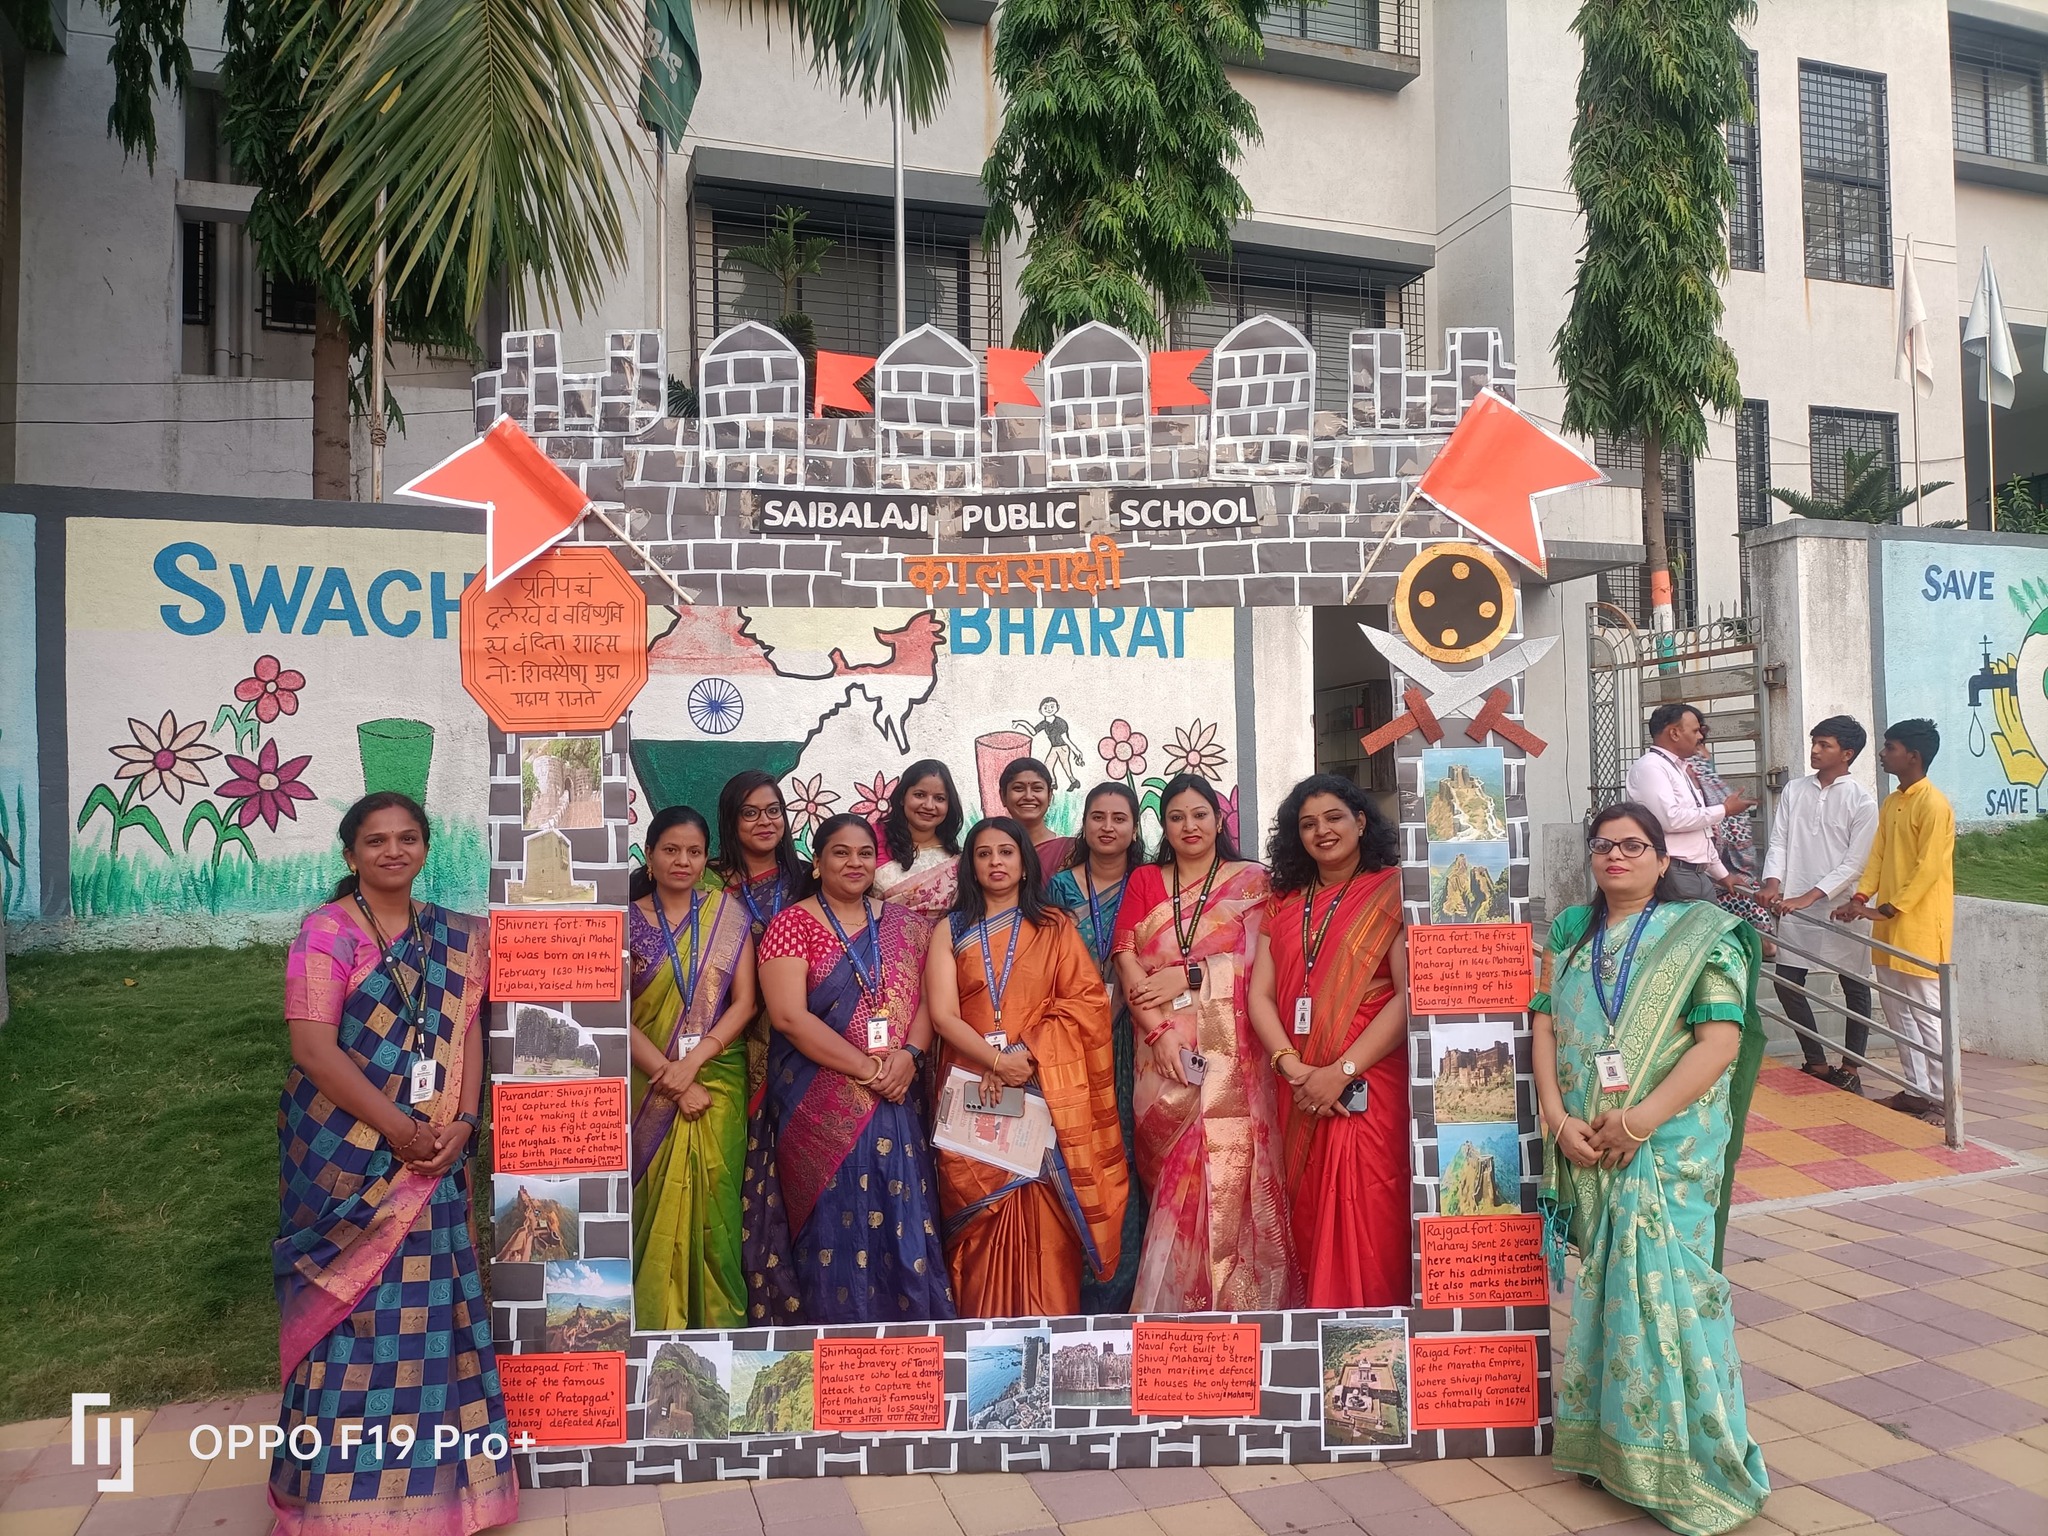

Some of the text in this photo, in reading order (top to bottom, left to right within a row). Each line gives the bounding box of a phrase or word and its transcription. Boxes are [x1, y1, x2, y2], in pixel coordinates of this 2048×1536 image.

[764, 498, 1256, 532] SAIBALAJI PUBLIC SCHOOL
[904, 535, 1124, 597] कालसाक्षी
[1922, 565, 1994, 601] SAVE
[949, 607, 1198, 658] BHARAT
[1985, 788, 2028, 816] SAVE
[498, 919, 606, 930] Shivneri This
[498, 935, 546, 944] is where
[1414, 933, 1445, 942] Torna
[1493, 930, 1516, 940] first
[1415, 943, 1525, 955] fort by Shivaji
[498, 952, 511, 962] raj
[544, 951, 568, 959] born
[1415, 961, 1454, 970] Maharaj
[499, 966, 593, 979] February 1630 His
[1440, 969, 1460, 980] just
[1502, 969, 1517, 977] This
[539, 980, 593, 990] raised him
[1416, 981, 1513, 994] the beginning of his
[556, 1088, 591, 1098] Shivaji
[571, 1099, 589, 1107] this
[594, 1097, 614, 1107] fort
[501, 1114, 510, 1122] in
[541, 1111, 575, 1122] making
[581, 1111, 588, 1119] it
[525, 1120, 621, 1135] of his fight against
[502, 1139, 516, 1148] the
[562, 1135, 581, 1143] This
[585, 1133, 606, 1143] fort
[500, 1144, 585, 1159] also birth of
[1427, 1221, 1535, 1240] Rajgad Shivaji
[1427, 1242, 1468, 1252] Maharaj
[1500, 1239, 1511, 1247] 26
[1427, 1254, 1496, 1265] here making
[1428, 1264, 1542, 1279] for his administration
[1429, 1281, 1439, 1290] It
[1443, 1280, 1463, 1289] also
[1470, 1278, 1499, 1288] marks
[1429, 1290, 1532, 1302] of his Rajaram
[1138, 1331, 1239, 1344] Shindhudurg A
[821, 1346, 938, 1359] Shinhagad Known
[1138, 1342, 1235, 1354] Naval fort built by
[1416, 1345, 1494, 1361] Raigad The
[821, 1362, 834, 1371] for
[839, 1361, 855, 1370] the
[858, 1360, 896, 1370] bravery
[902, 1359, 912, 1368] of
[1172, 1355, 1213, 1365] Maharaj
[502, 1362, 559, 1375] Pratapgad
[1168, 1366, 1214, 1375] maritime
[1417, 1364, 1426, 1373] of
[1429, 1363, 1442, 1371] the
[871, 1370, 889, 1379] who
[1417, 1372, 1521, 1387] where Maharaj
[526, 1377, 605, 1387] of the famous
[1154, 1378, 1187, 1387] houses
[1194, 1379, 1206, 1387] the
[1211, 1380, 1228, 1392] only
[822, 1386, 854, 1395] attack
[860, 1384, 870, 1392] to
[1442, 1387, 1482, 1399] formally
[540, 1392, 551, 1401] of
[822, 1391, 934, 1407] fort famously
[1138, 1391, 1196, 1401] dedicated to
[1506, 1398, 1526, 1406] 1674
[520, 1408, 540, 1416] 1659
[822, 1404, 905, 1416] mourned his loss
[549, 1418, 593, 1427] defeated
